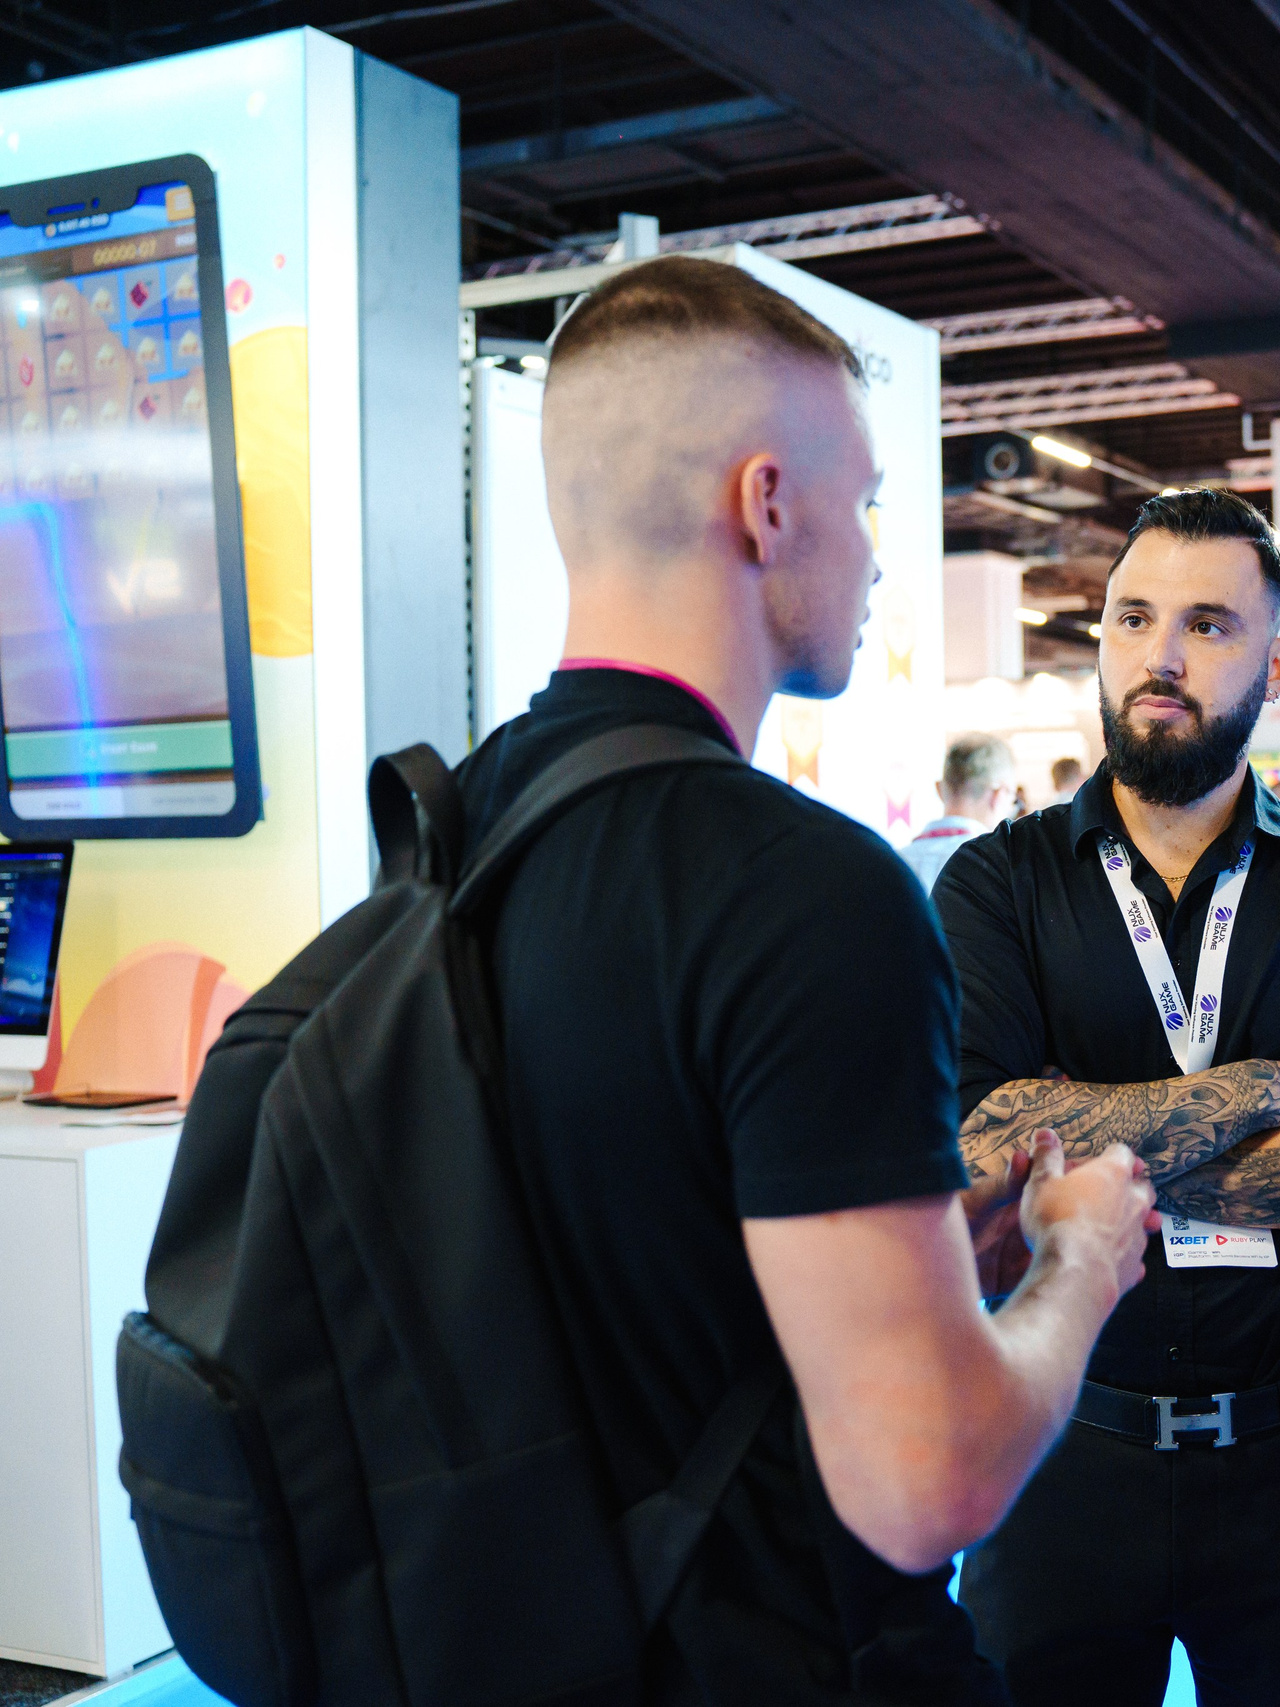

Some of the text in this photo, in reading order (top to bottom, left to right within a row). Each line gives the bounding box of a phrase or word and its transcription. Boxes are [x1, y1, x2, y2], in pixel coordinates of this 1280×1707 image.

[1127, 908, 1139, 927] NUX
[1130, 900, 1145, 926] GAME
[1210, 922, 1221, 951] GAME
[1217, 922, 1228, 943] NUX
[1158, 992, 1171, 1014] NUX
[1161, 982, 1177, 1011] GAME
[1198, 1012, 1208, 1043] GAME
[1206, 1013, 1215, 1036] NUX
[1169, 1236, 1209, 1245] 1XBET
